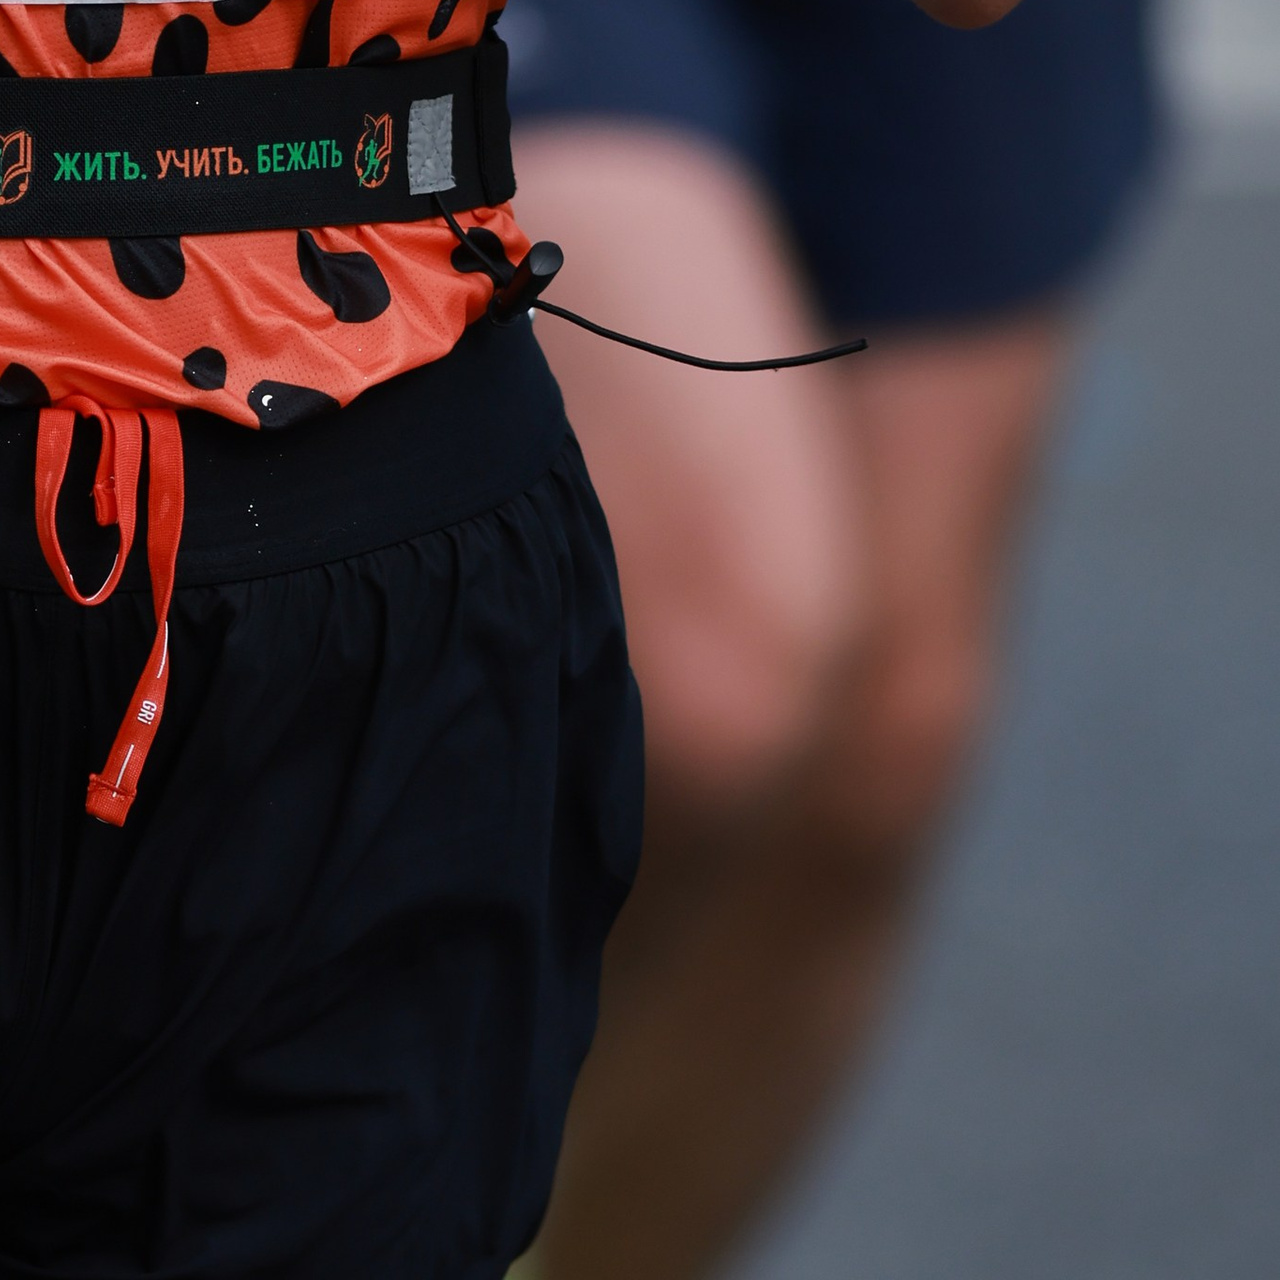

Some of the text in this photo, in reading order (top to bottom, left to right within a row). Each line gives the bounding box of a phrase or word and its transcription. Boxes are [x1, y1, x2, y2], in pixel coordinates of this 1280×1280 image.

[53, 139, 343, 182] ЖИТЬ. УЧИТЬ. БЕЖАТЬ
